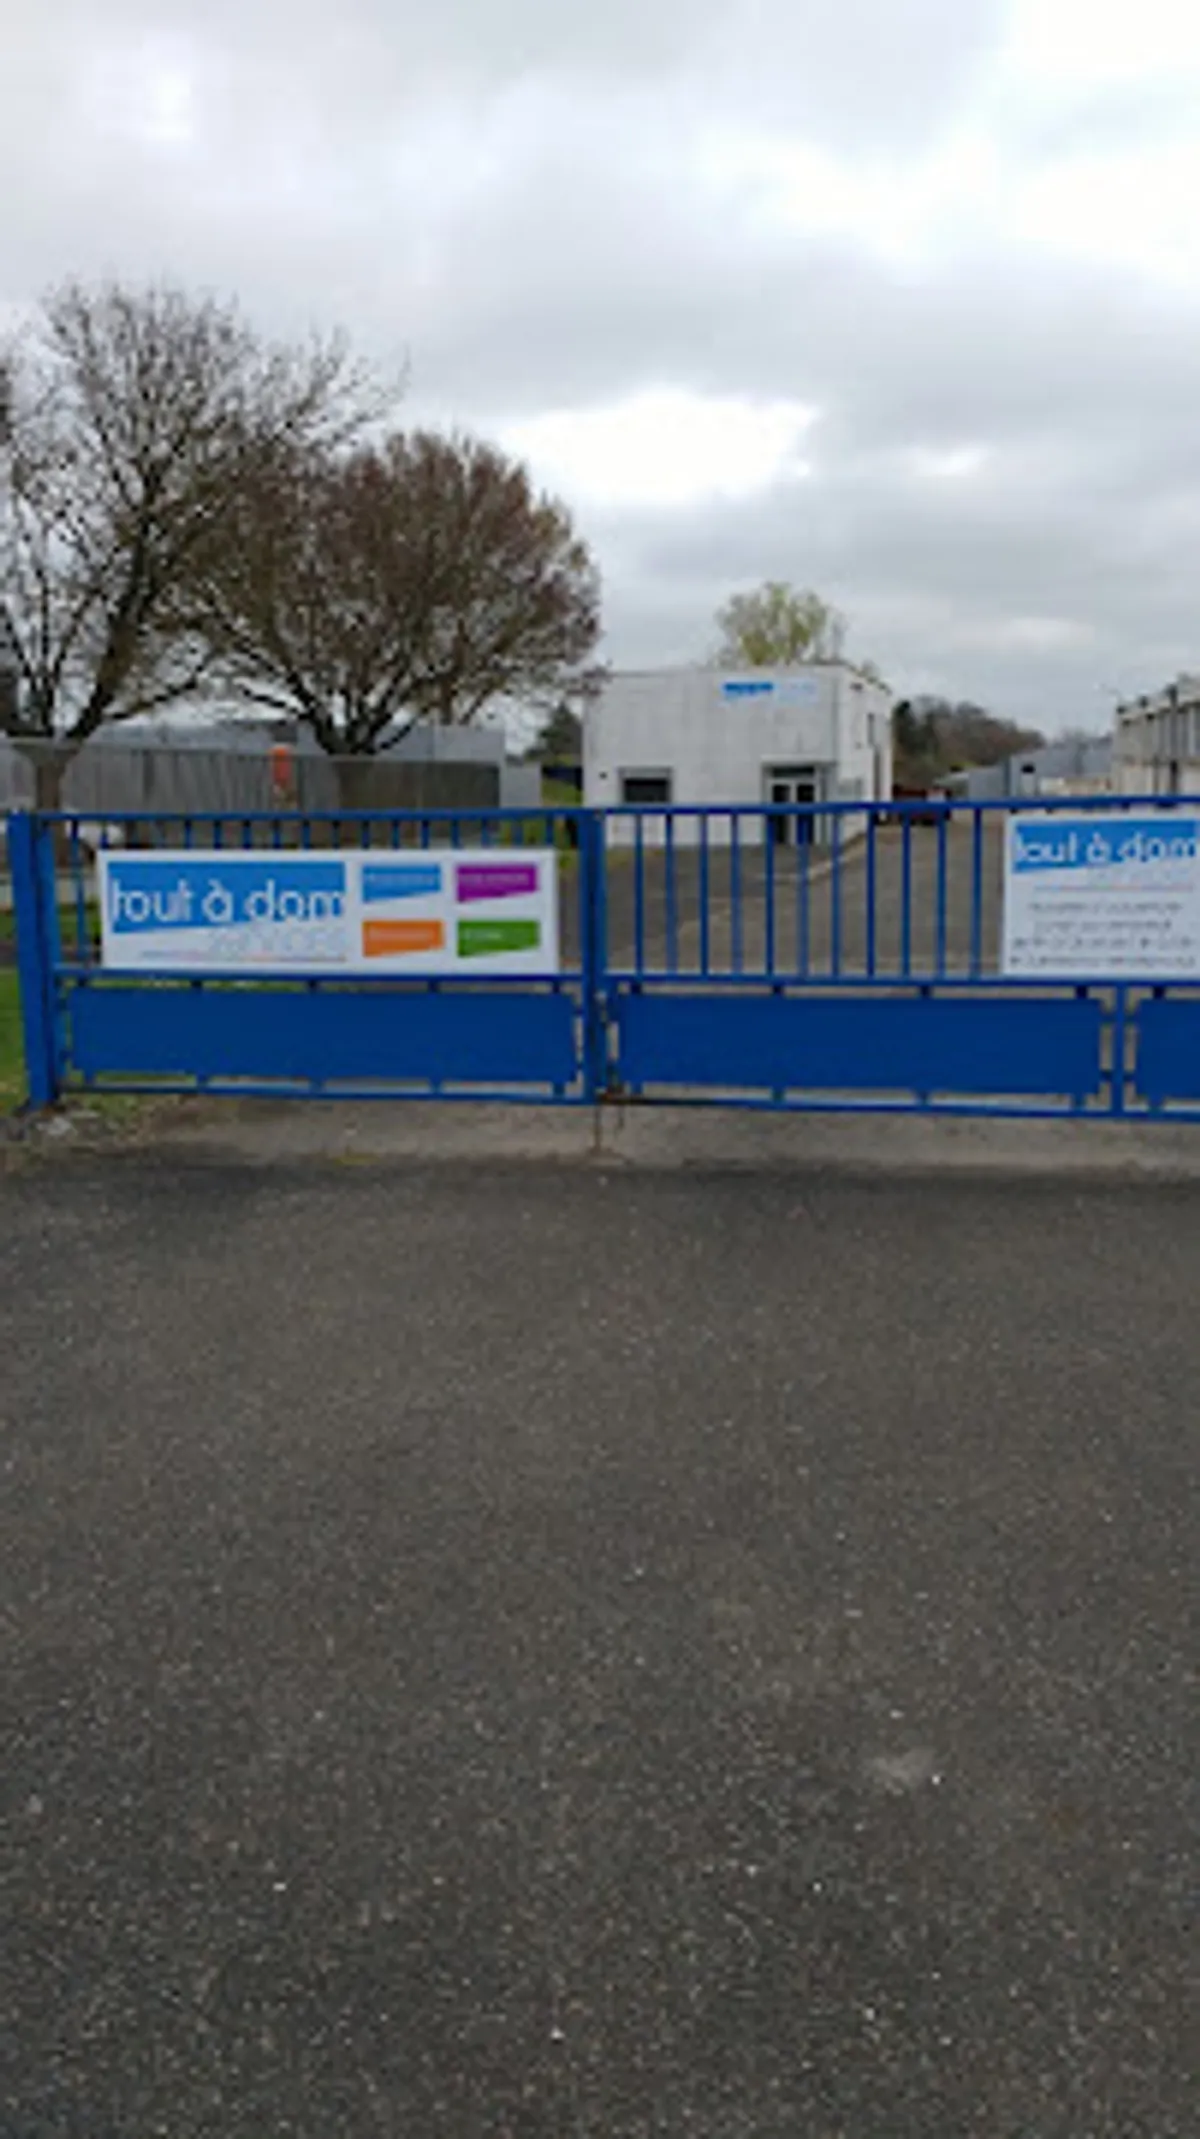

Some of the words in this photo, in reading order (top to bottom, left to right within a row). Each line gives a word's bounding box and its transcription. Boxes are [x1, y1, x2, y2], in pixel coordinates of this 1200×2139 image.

[1117, 830, 1198, 863] dom
[109, 878, 193, 923] tout
[202, 879, 234, 923] à
[245, 879, 346, 923] dom
